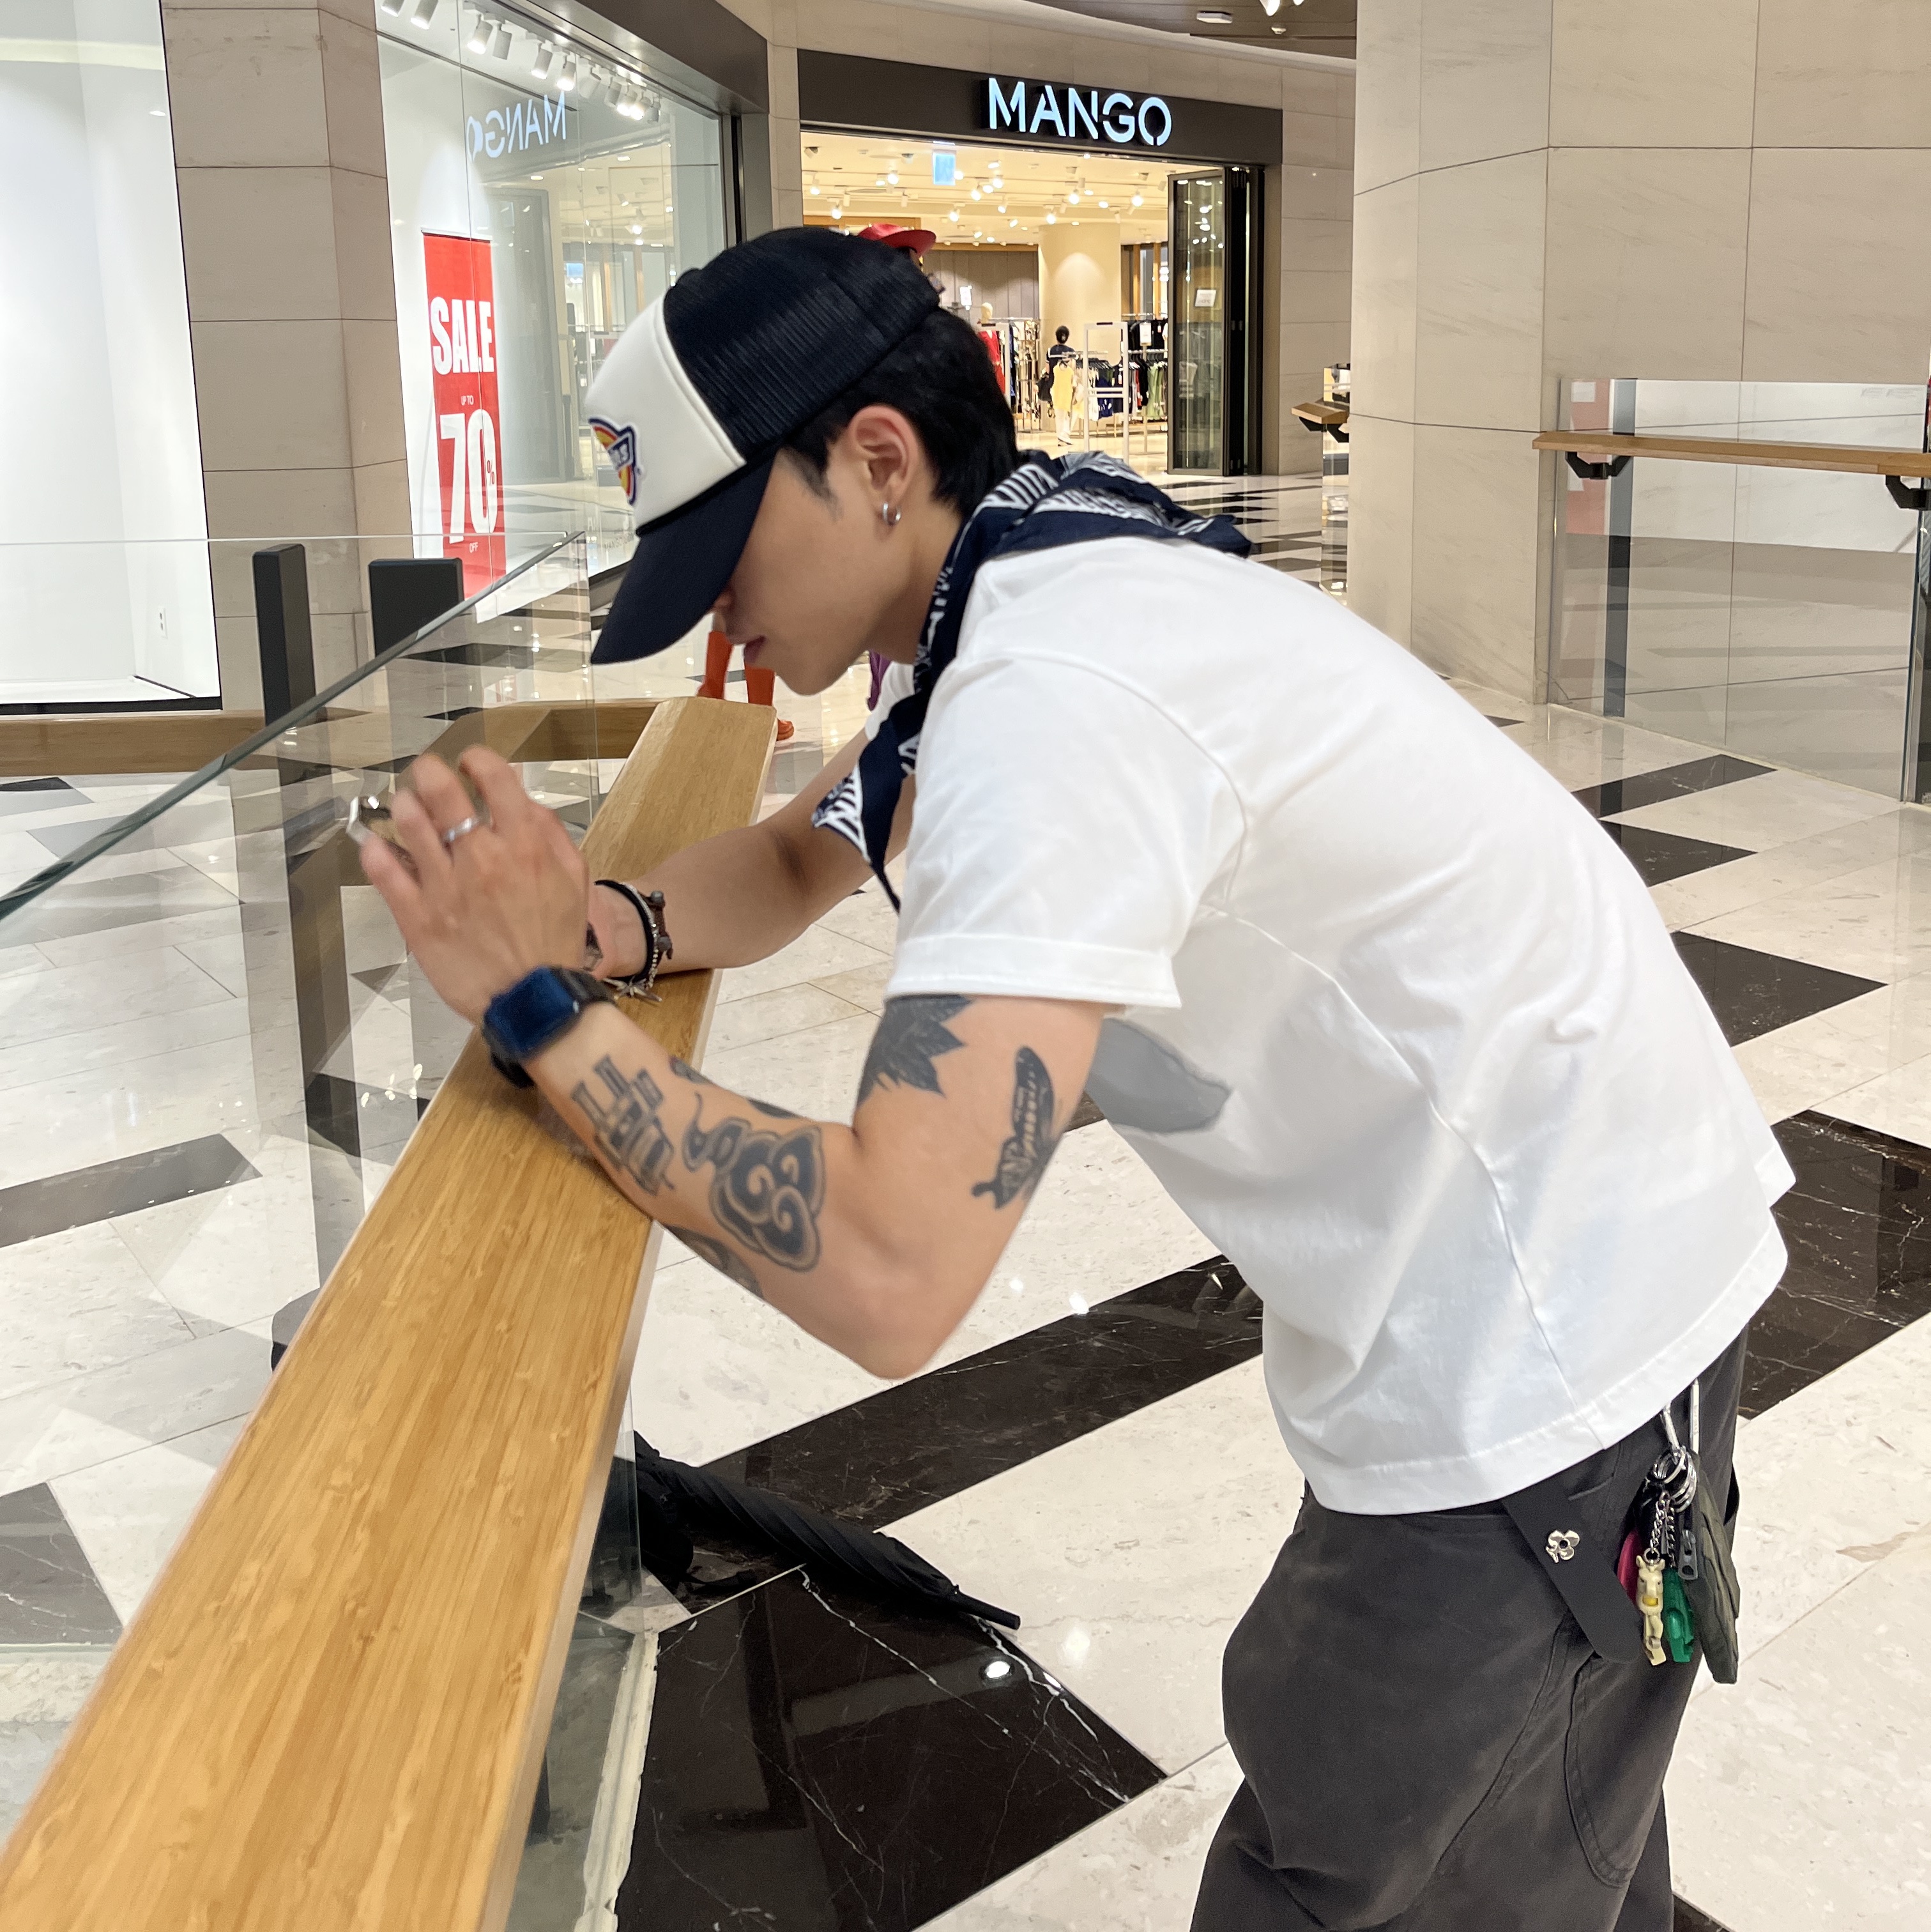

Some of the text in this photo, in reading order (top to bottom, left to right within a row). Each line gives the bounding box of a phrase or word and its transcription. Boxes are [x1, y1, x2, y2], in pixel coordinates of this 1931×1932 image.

[989, 77, 1172, 146] MANGO
[431, 296, 495, 375] SALE
[461, 395, 474, 406] UP TO
[469, 542, 479, 553] OFF
